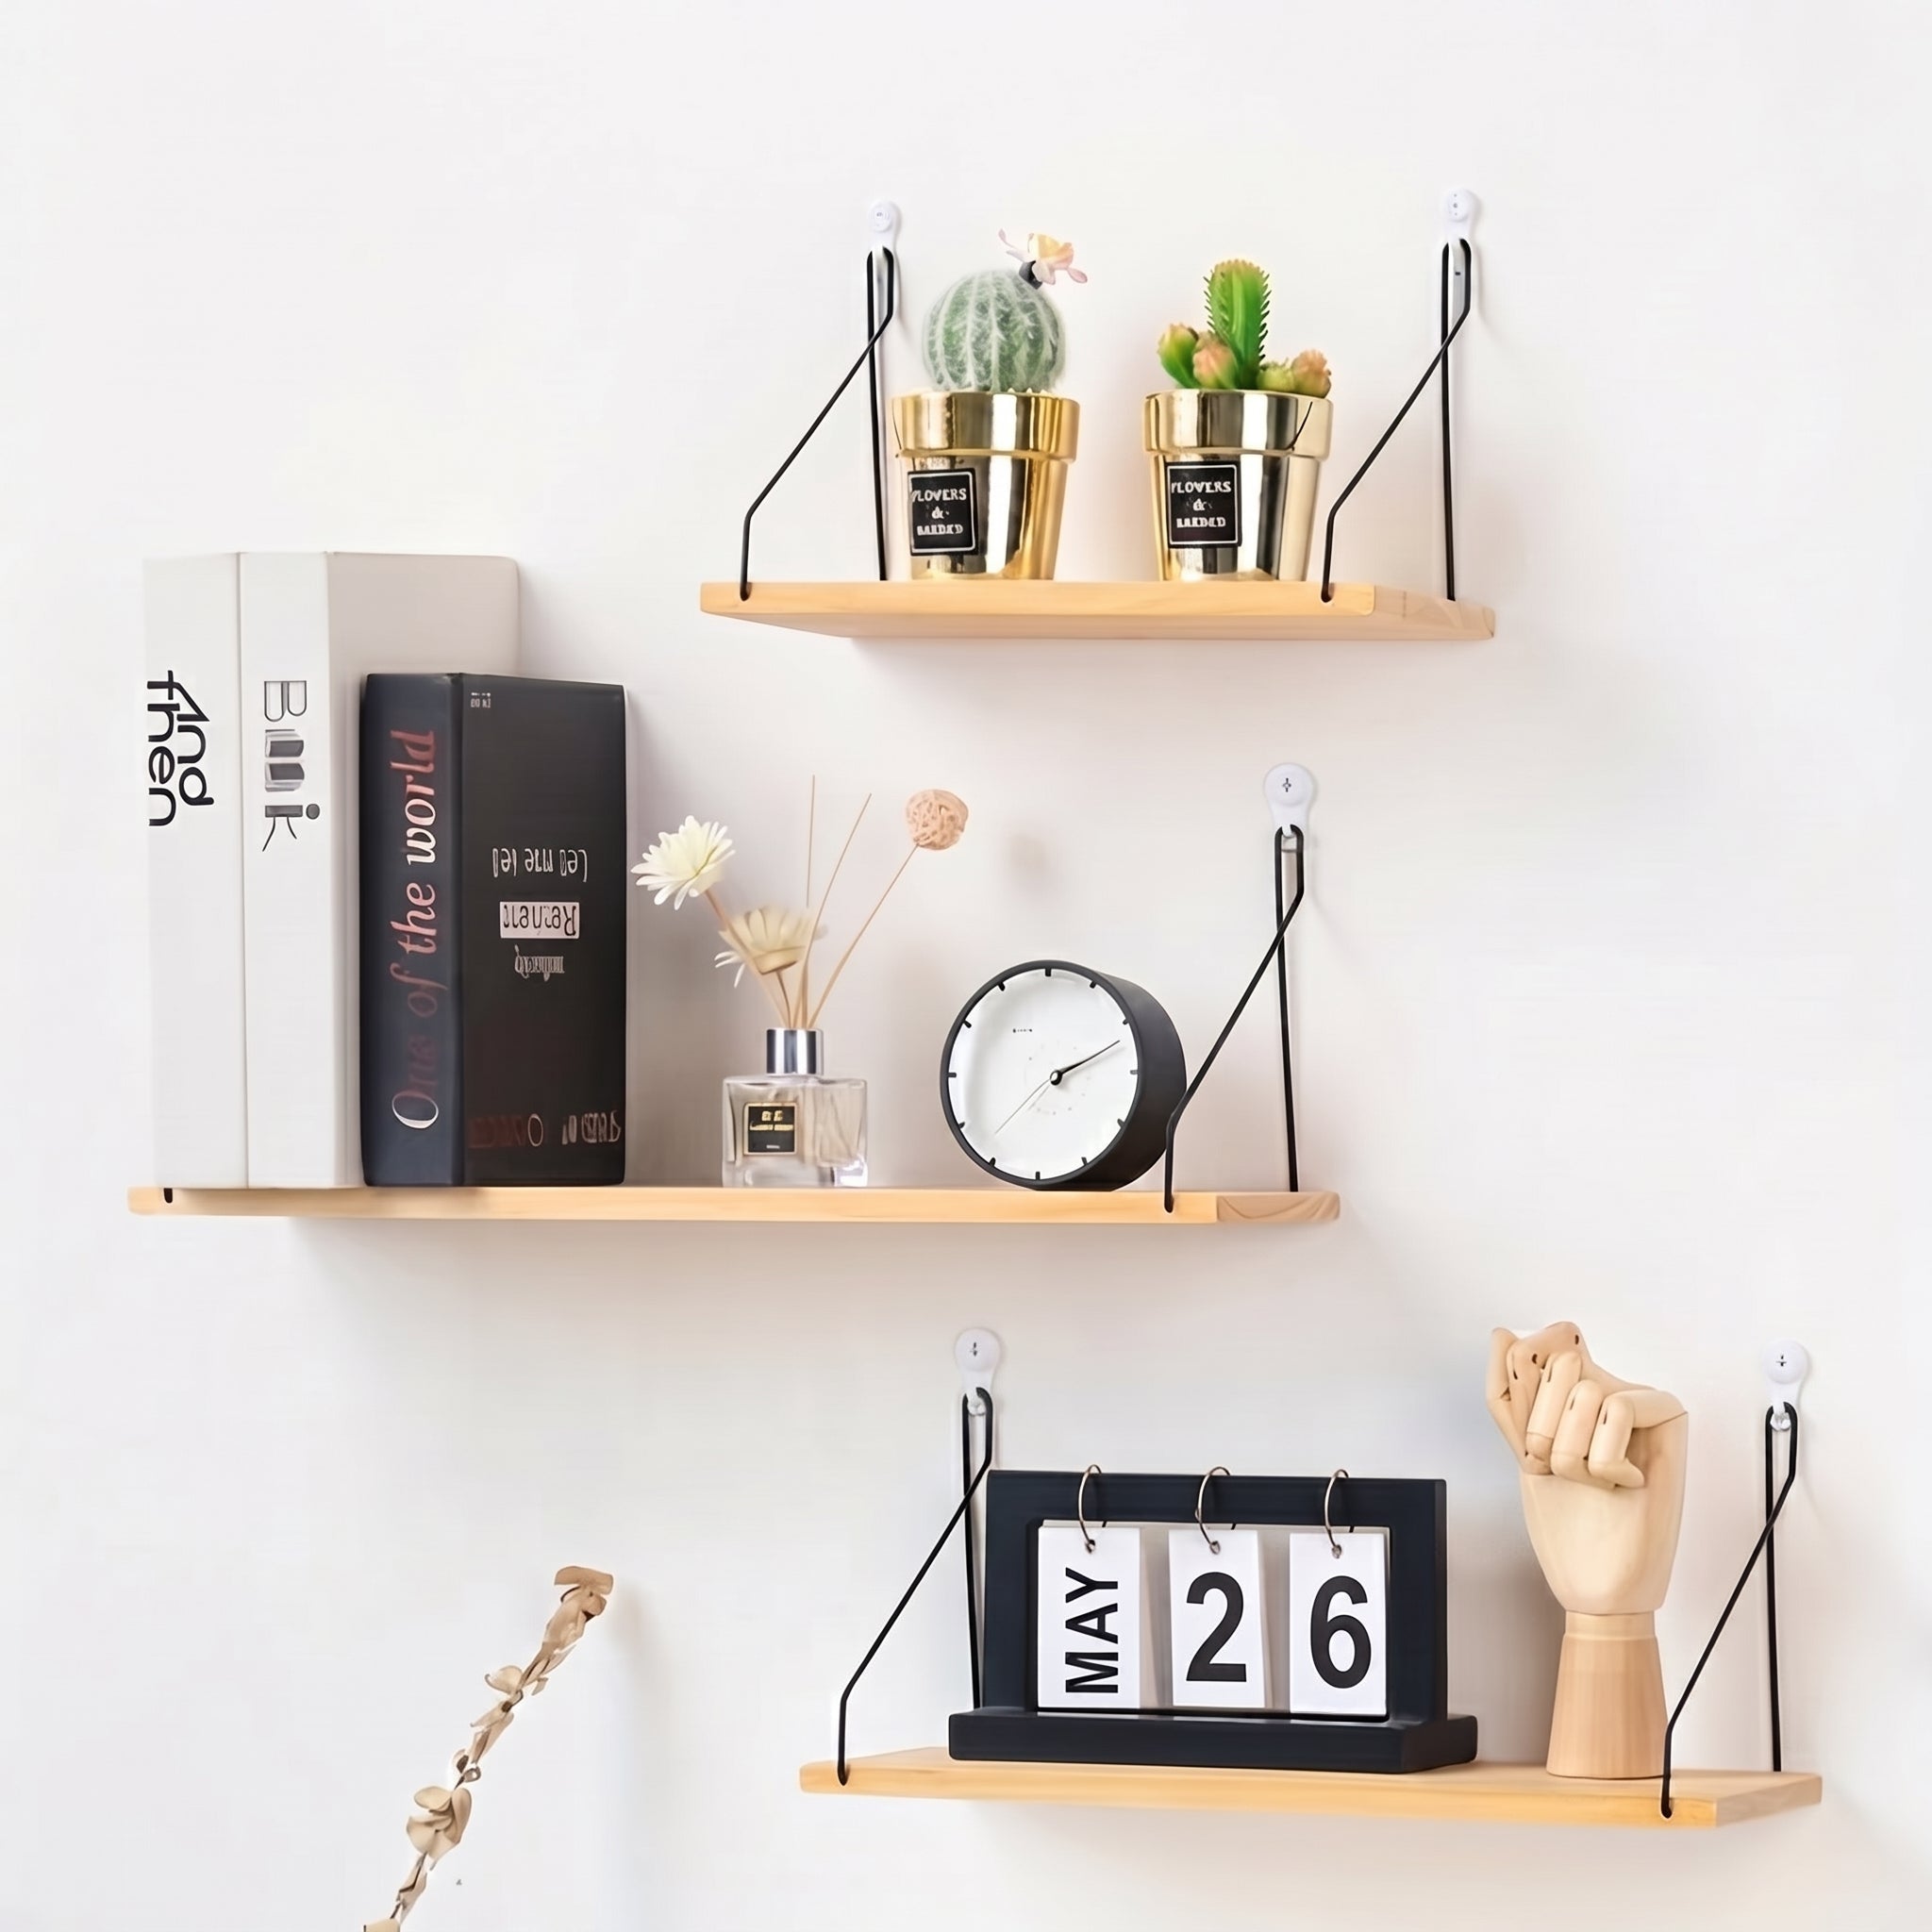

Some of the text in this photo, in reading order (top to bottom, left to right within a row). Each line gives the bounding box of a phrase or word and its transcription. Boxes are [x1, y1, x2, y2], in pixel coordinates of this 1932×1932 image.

[175, 680, 215, 806] And
[390, 729, 437, 866] world
[391, 882, 438, 955] the
[390, 962, 449, 1018] of
[1065, 1567, 1119, 1693] MAY
[1186, 1572, 1372, 1689] 2 6
